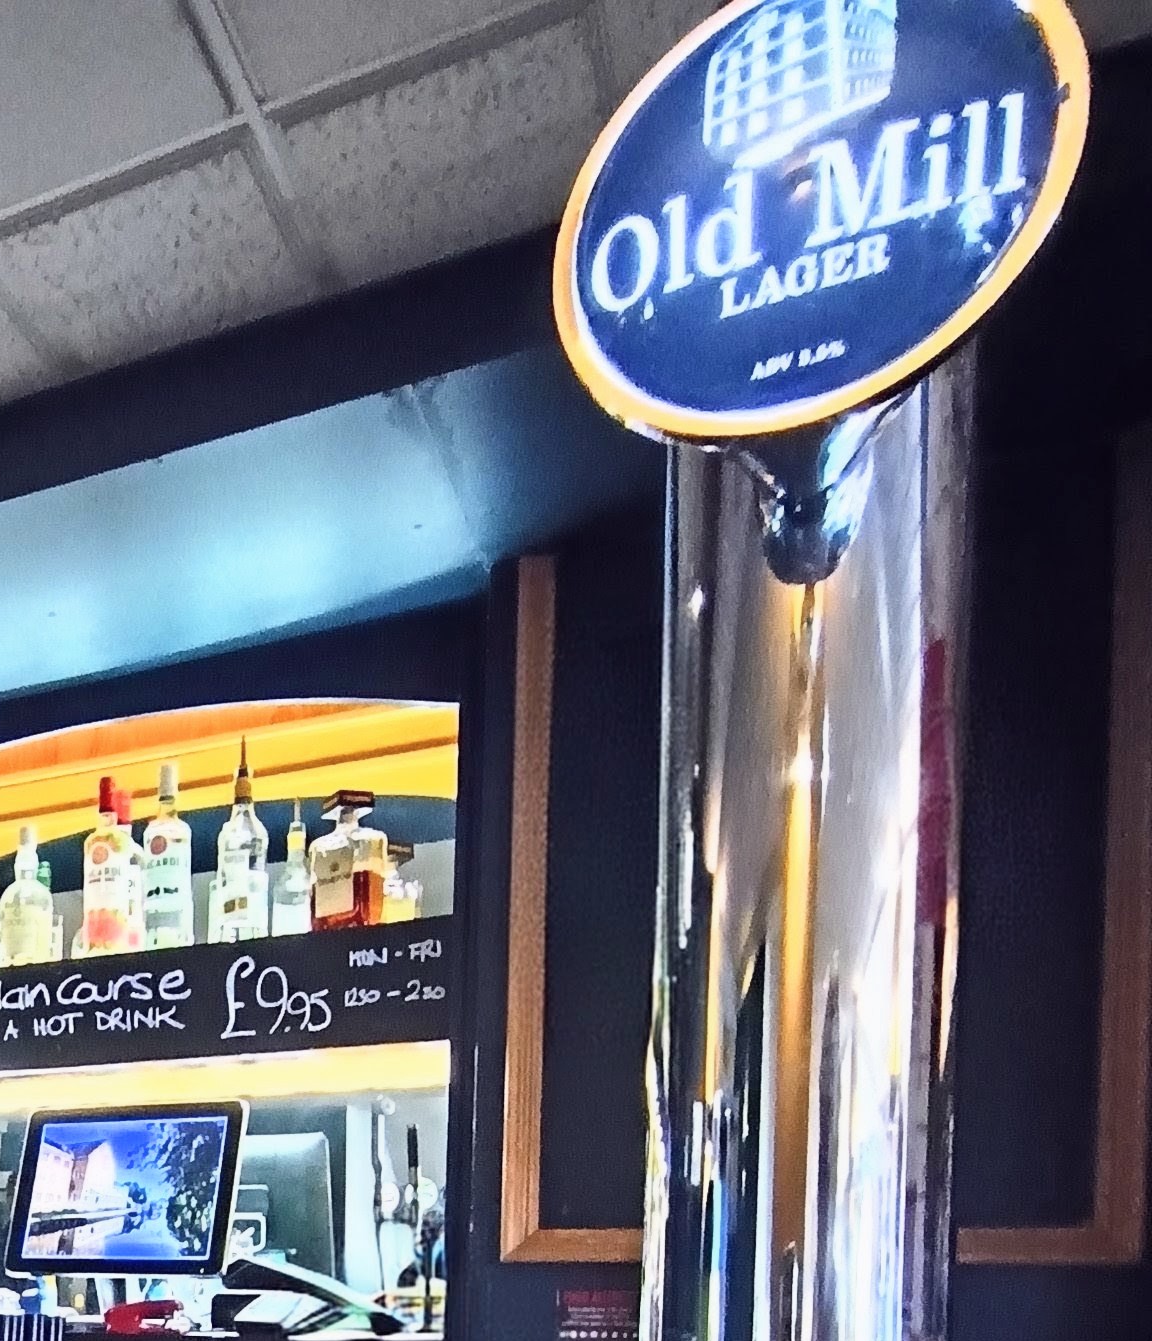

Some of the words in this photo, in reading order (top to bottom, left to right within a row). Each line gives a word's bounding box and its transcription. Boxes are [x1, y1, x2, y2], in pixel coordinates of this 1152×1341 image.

[591, 168, 762, 313] Old
[805, 93, 1027, 249] Mill
[720, 233, 891, 320] LAGER
[408, 939, 442, 962] FRI
[55, 969, 192, 1006] Course
[220, 955, 333, 1039] £9.95
[3, 1018, 19, 1042] A
[34, 1011, 84, 1037] HOT
[95, 1005, 186, 1032] DRINK
